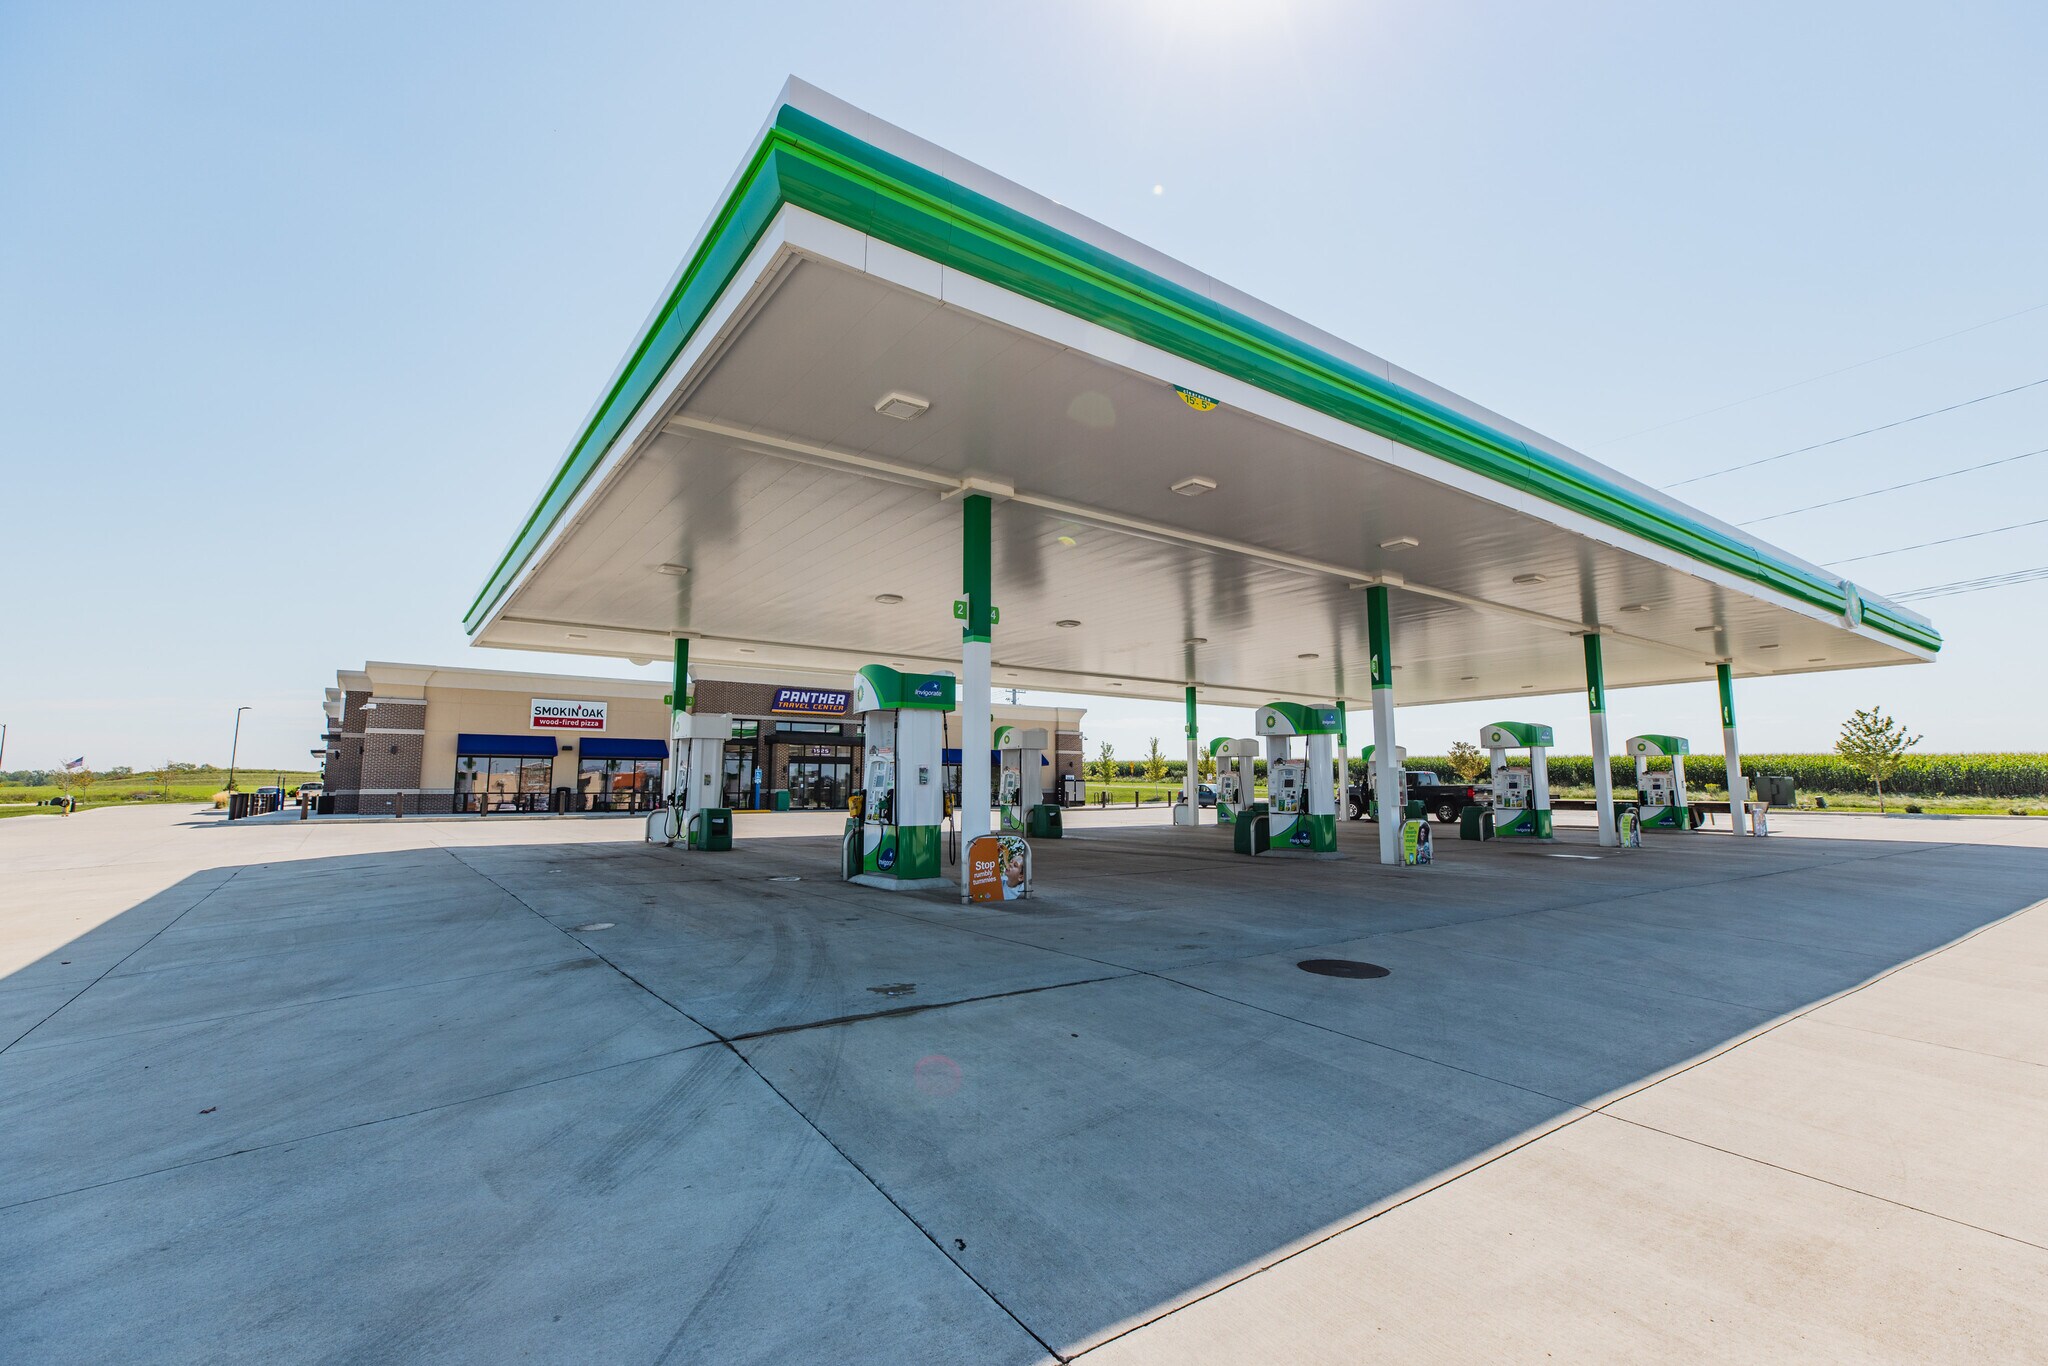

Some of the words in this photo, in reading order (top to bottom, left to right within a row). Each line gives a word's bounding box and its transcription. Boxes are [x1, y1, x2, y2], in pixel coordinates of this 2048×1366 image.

[957, 604, 964, 615] 2
[991, 609, 996, 620] 4
[780, 690, 846, 704] PANTHER
[915, 687, 942, 698] Invigorate
[581, 708, 604, 718] OAK
[539, 718, 580, 727] wood-fired
[580, 719, 599, 728] pizza
[975, 861, 996, 870] Stop
